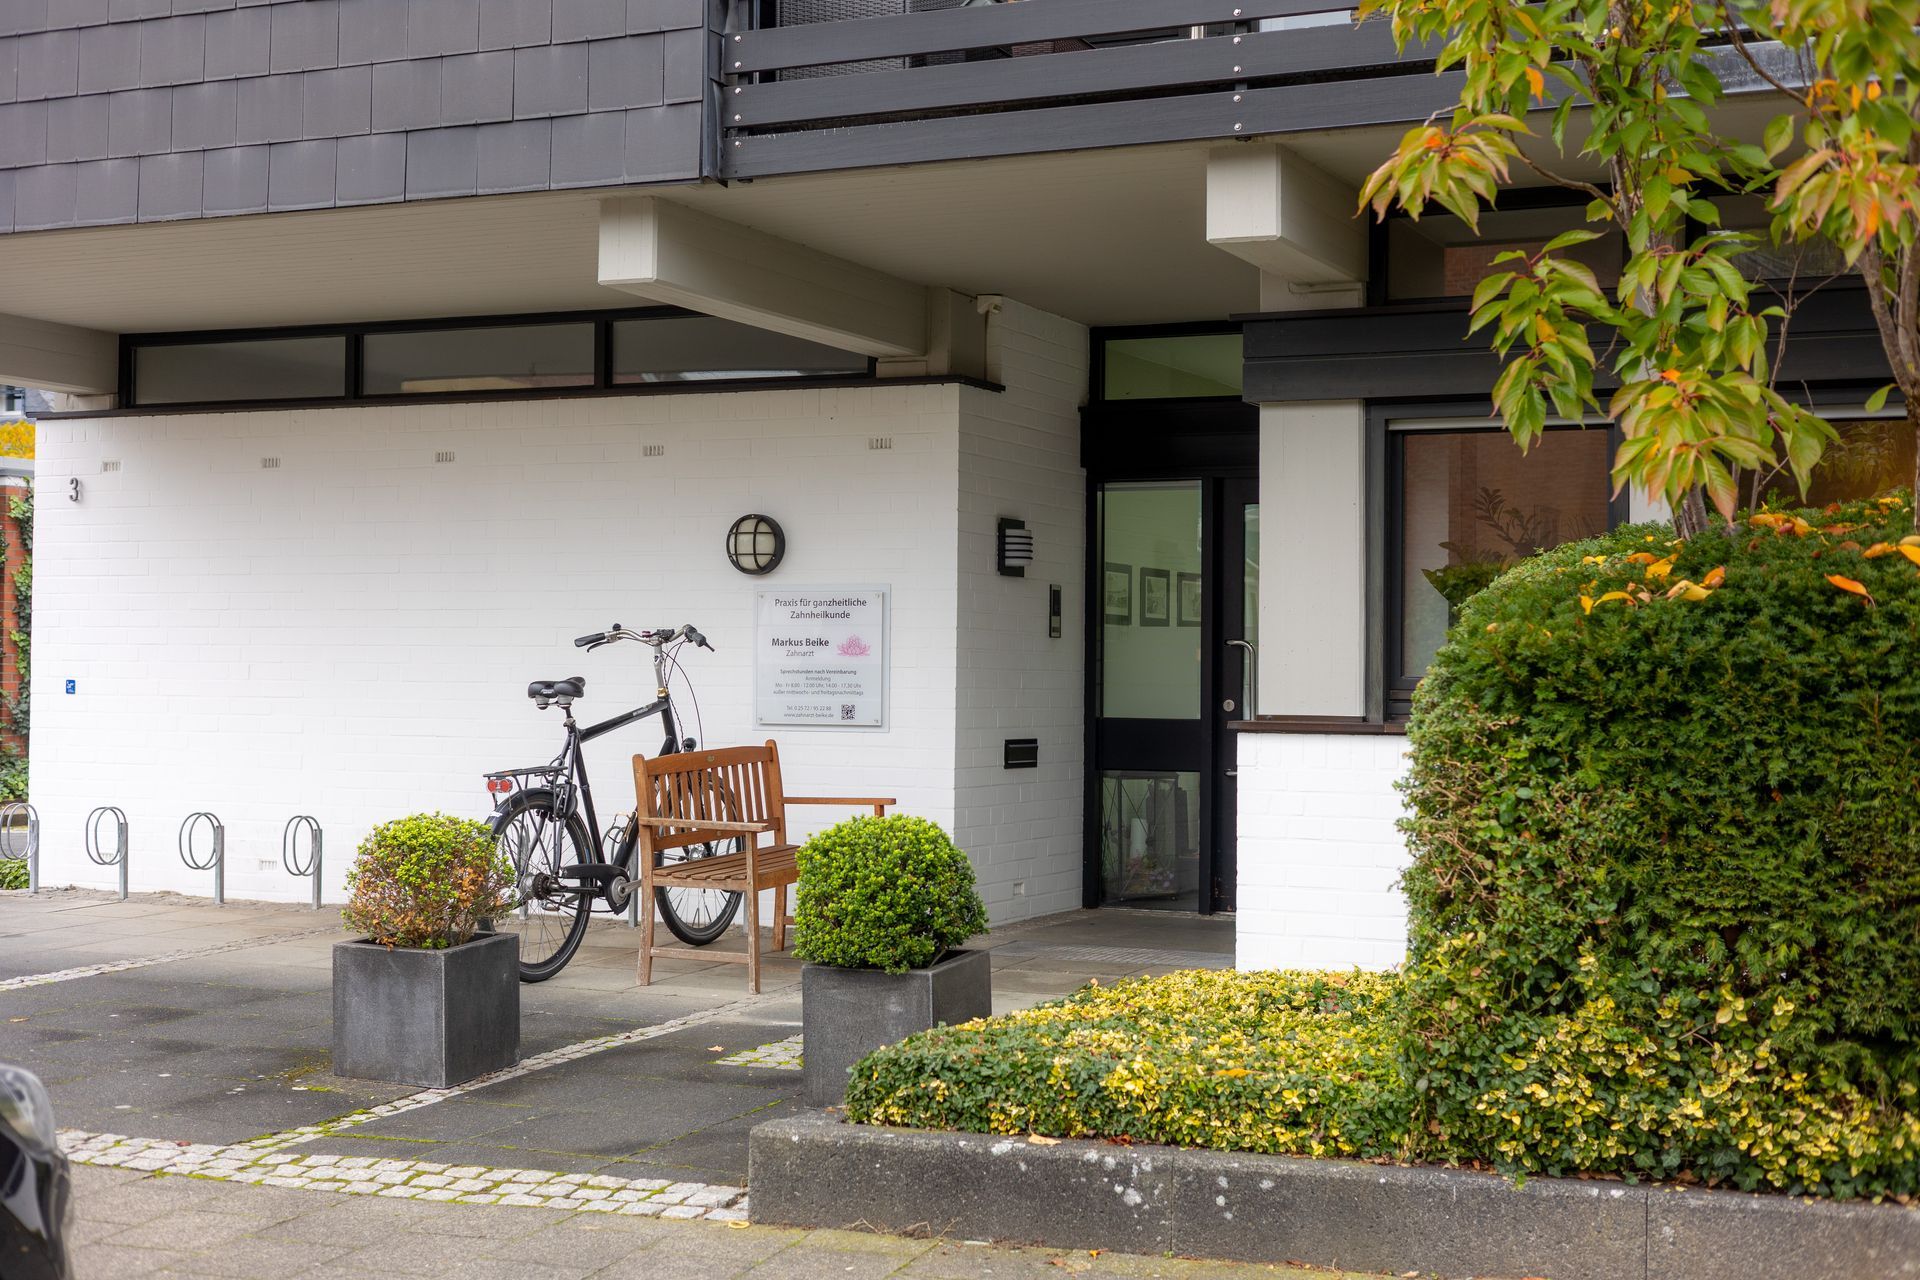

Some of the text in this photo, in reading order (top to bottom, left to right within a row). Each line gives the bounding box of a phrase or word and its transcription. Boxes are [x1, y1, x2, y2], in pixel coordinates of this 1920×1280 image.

[70, 477, 78, 502] 3
[774, 598, 867, 608] Praxis für ganzheitliche
[790, 610, 850, 619] Zahnheilkunde
[772, 638, 830, 646] Markus Beike
